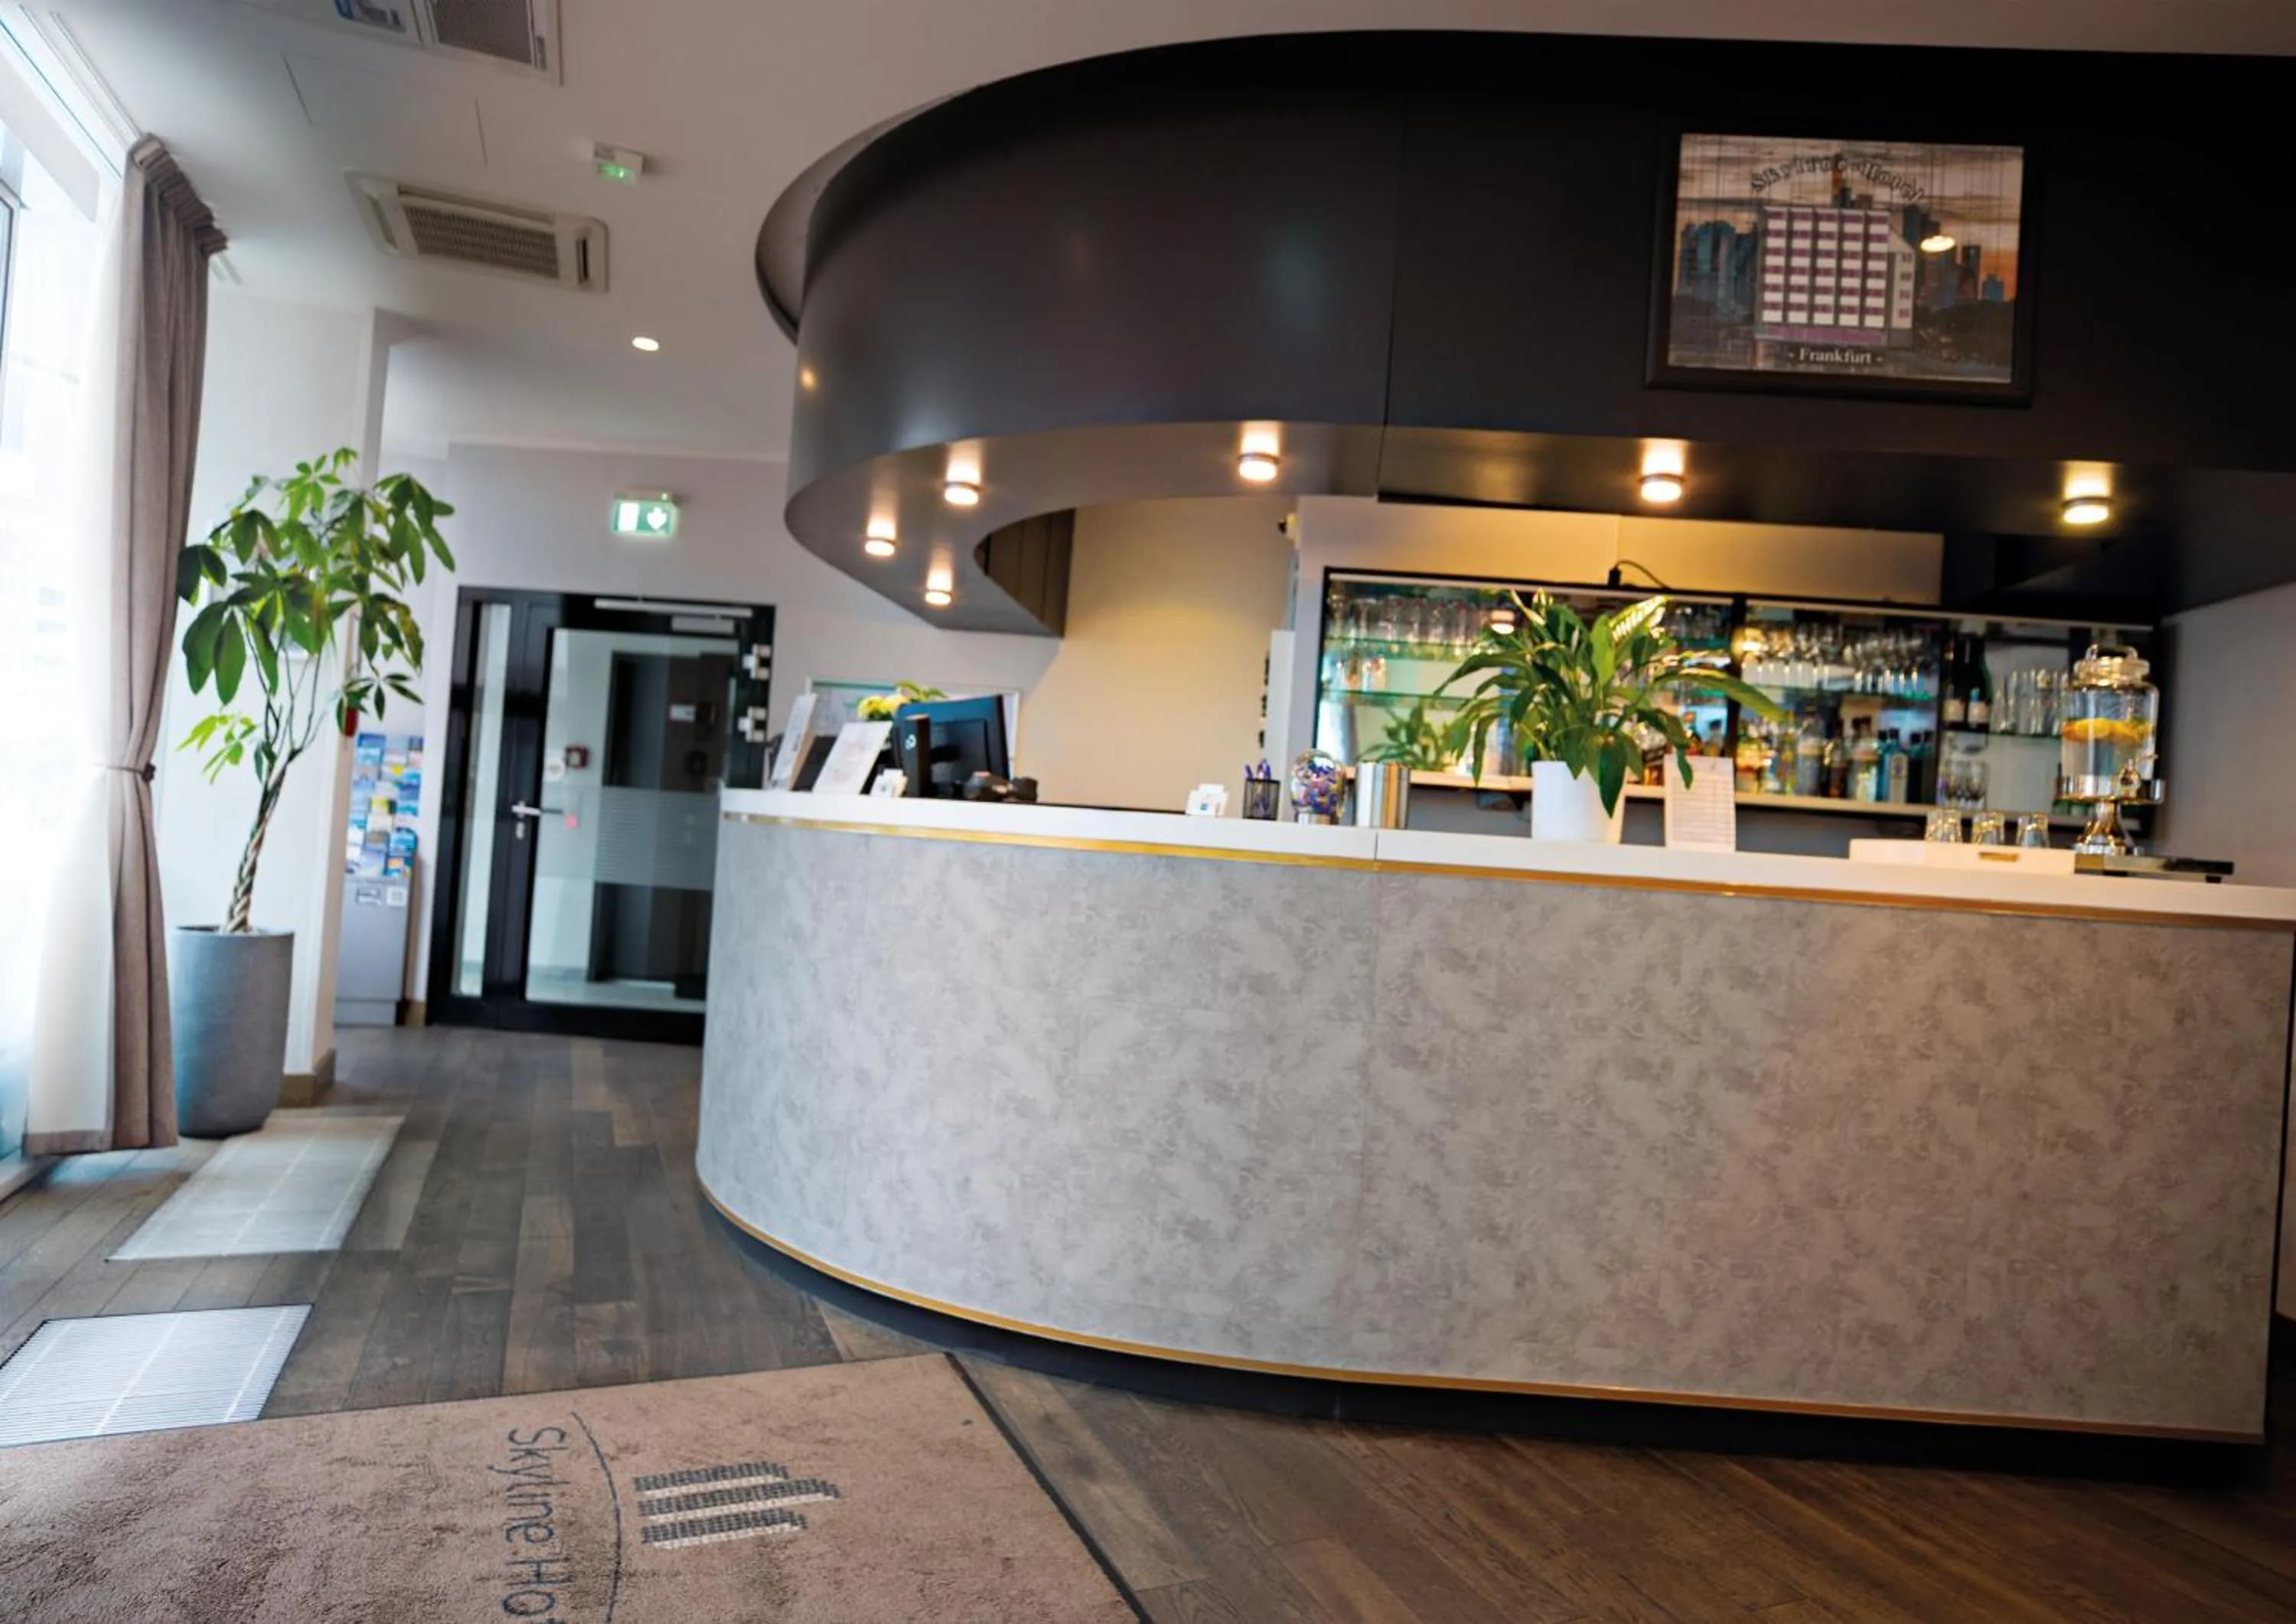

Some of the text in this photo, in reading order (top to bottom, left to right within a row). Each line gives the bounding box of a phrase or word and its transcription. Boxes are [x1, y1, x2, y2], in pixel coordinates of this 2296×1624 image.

[1799, 346, 1872, 364] Frankfurt
[488, 1426, 575, 1624] Skyline Ho
